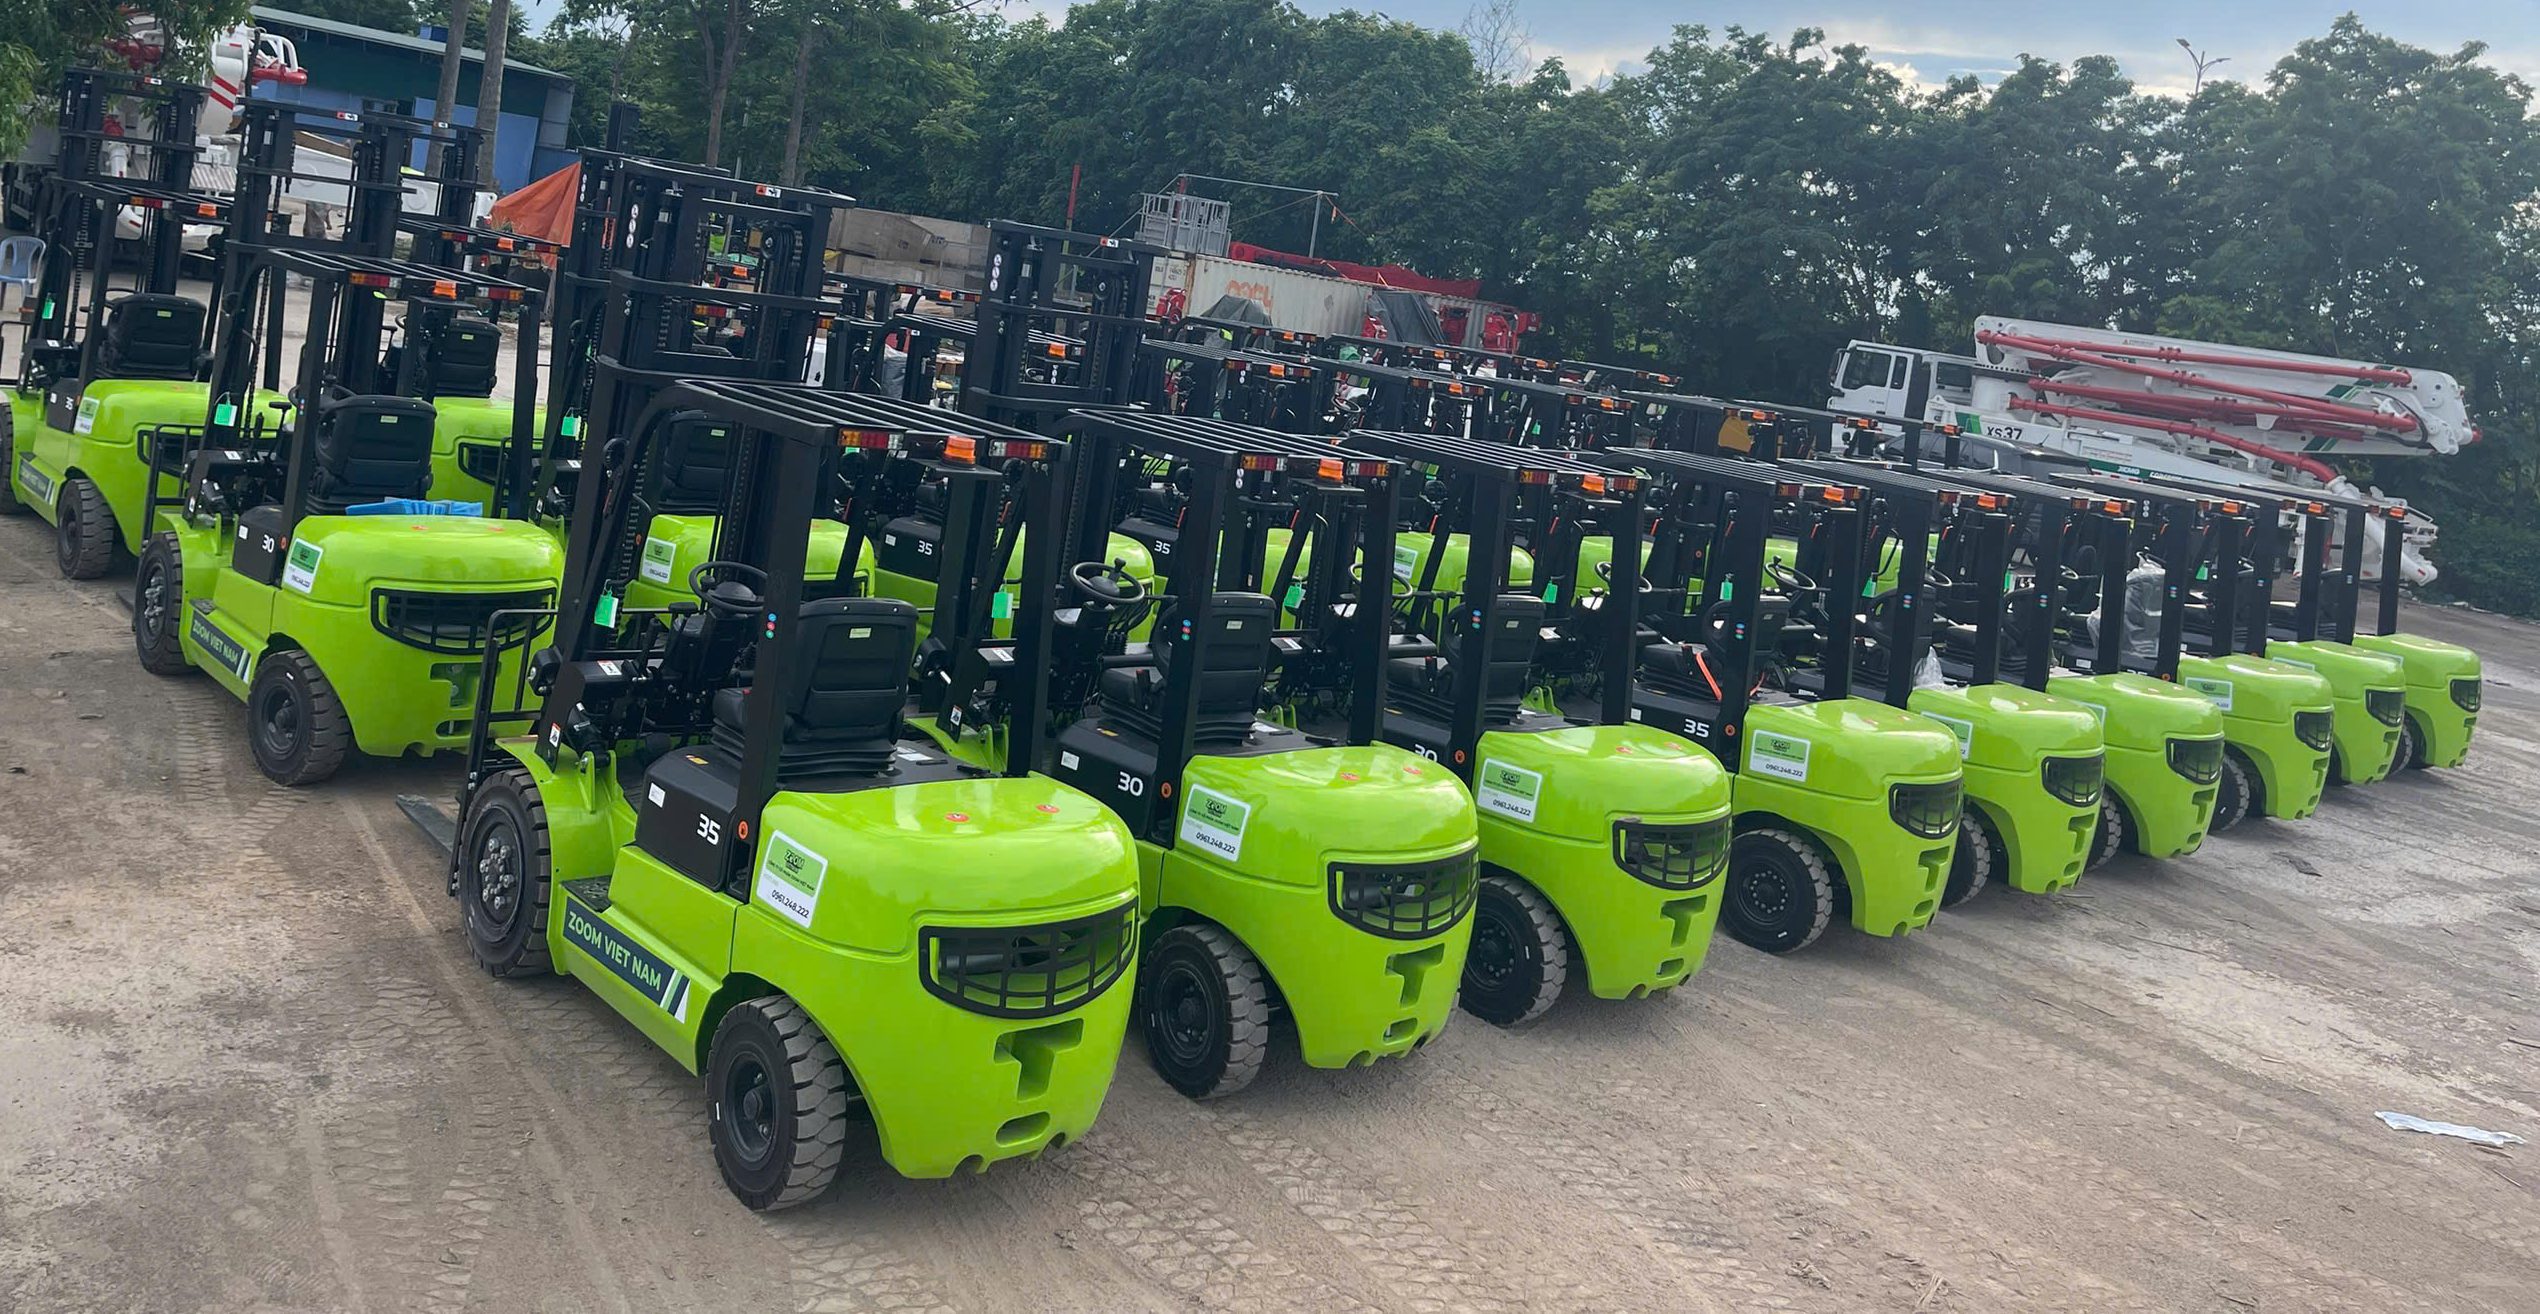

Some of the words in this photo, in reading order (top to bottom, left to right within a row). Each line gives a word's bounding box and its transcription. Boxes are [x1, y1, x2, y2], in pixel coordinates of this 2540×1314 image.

[262, 534, 275, 553] 30
[917, 540, 933, 556] 35
[1154, 540, 1171, 555] 35
[1683, 718, 1710, 738] 35
[1117, 771, 1144, 797] 30
[1492, 799, 1531, 816] 0961.248.222
[696, 813, 721, 845] 35
[1195, 832, 1236, 854] 0961.248.222
[771, 889, 810, 919] 0961.248.222
[568, 911, 602, 949] ZOOM
[604, 935, 631, 968] VIET
[631, 955, 661, 991] NAM
